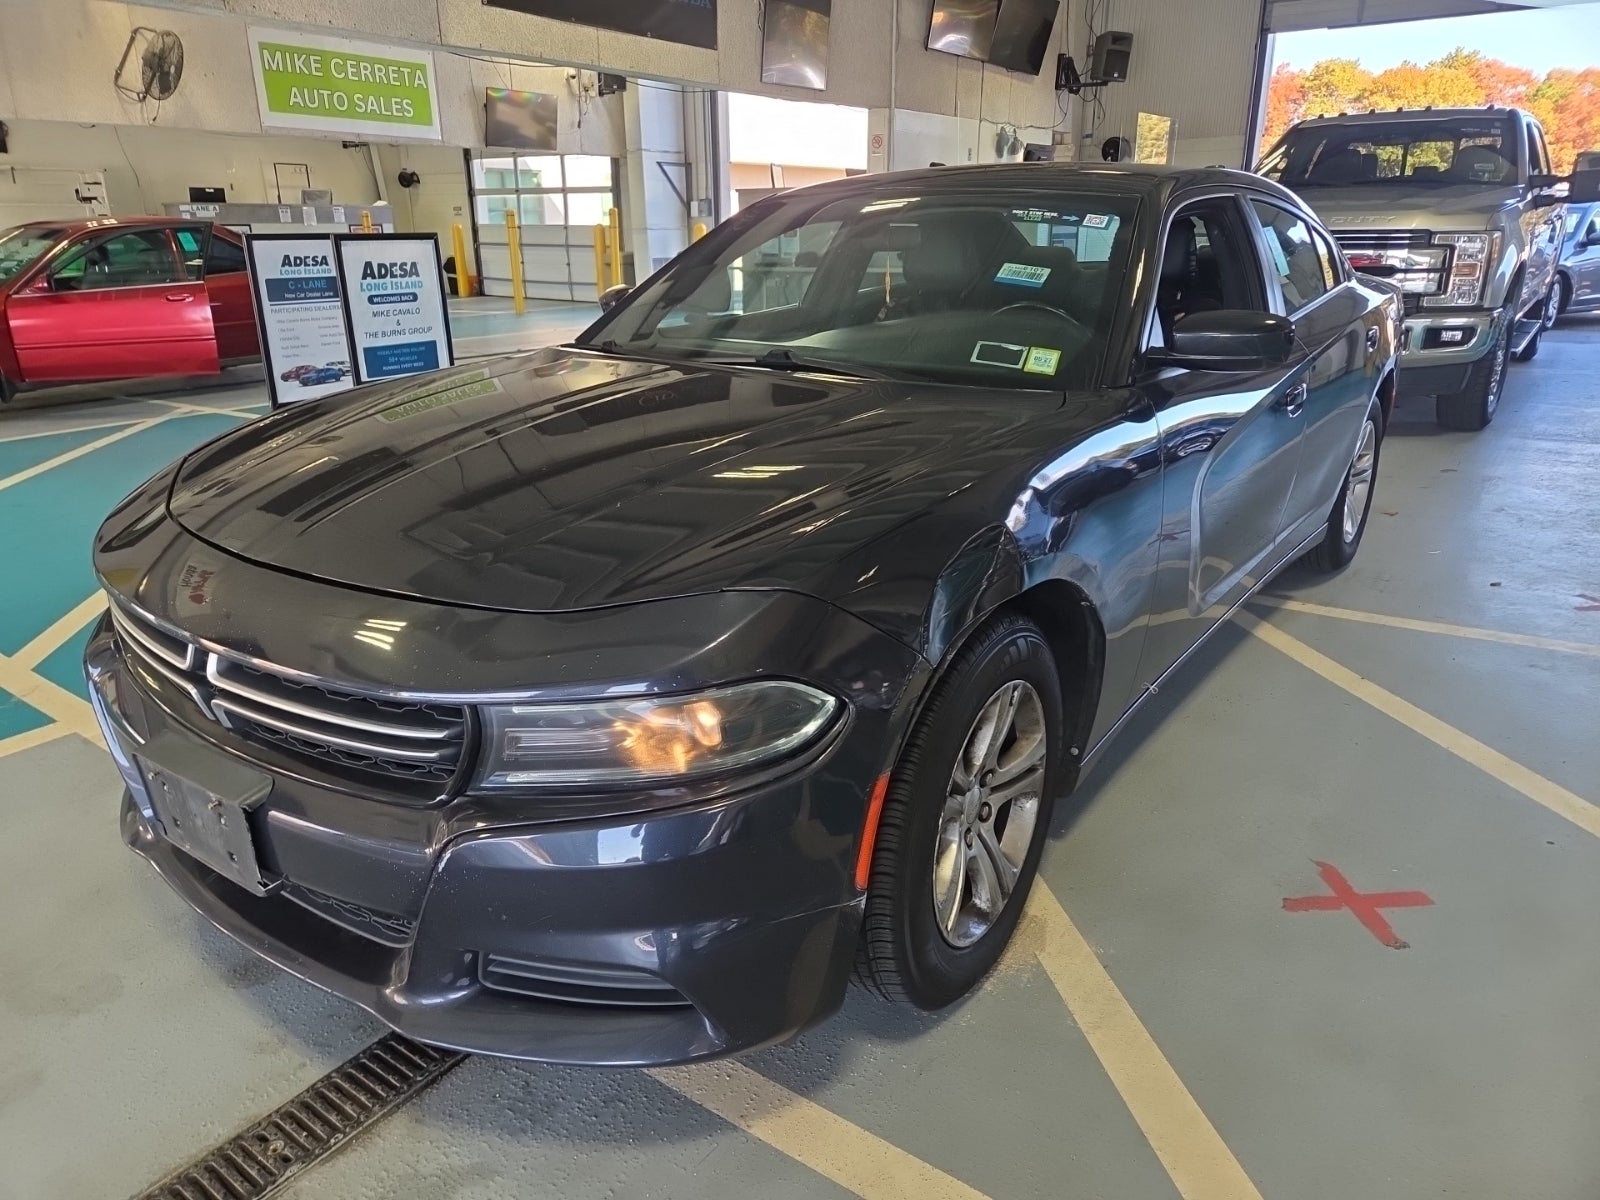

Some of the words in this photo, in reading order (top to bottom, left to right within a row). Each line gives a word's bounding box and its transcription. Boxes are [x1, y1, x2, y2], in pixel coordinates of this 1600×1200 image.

[262, 48, 324, 77] MIKE
[330, 58, 428, 89] CERRETA
[289, 87, 348, 113] AUTO
[353, 94, 415, 118] SALES
[190, 204, 211, 212] LANE
[281, 255, 329, 268] ADESA
[304, 267, 332, 275] ISLAND
[362, 261, 420, 280] ADESA
[288, 281, 295, 289] C
[303, 279, 328, 289] LANE
[359, 281, 389, 293] LONG
[390, 280, 424, 291] ISLAND
[401, 294, 413, 302] BACK
[270, 306, 313, 315] PARTICIPATING
[371, 309, 391, 317] MIKE
[392, 307, 421, 316] CAVALO
[364, 331, 379, 340] THE
[380, 329, 406, 338] BURNS
[407, 326, 433, 337] GROUP
